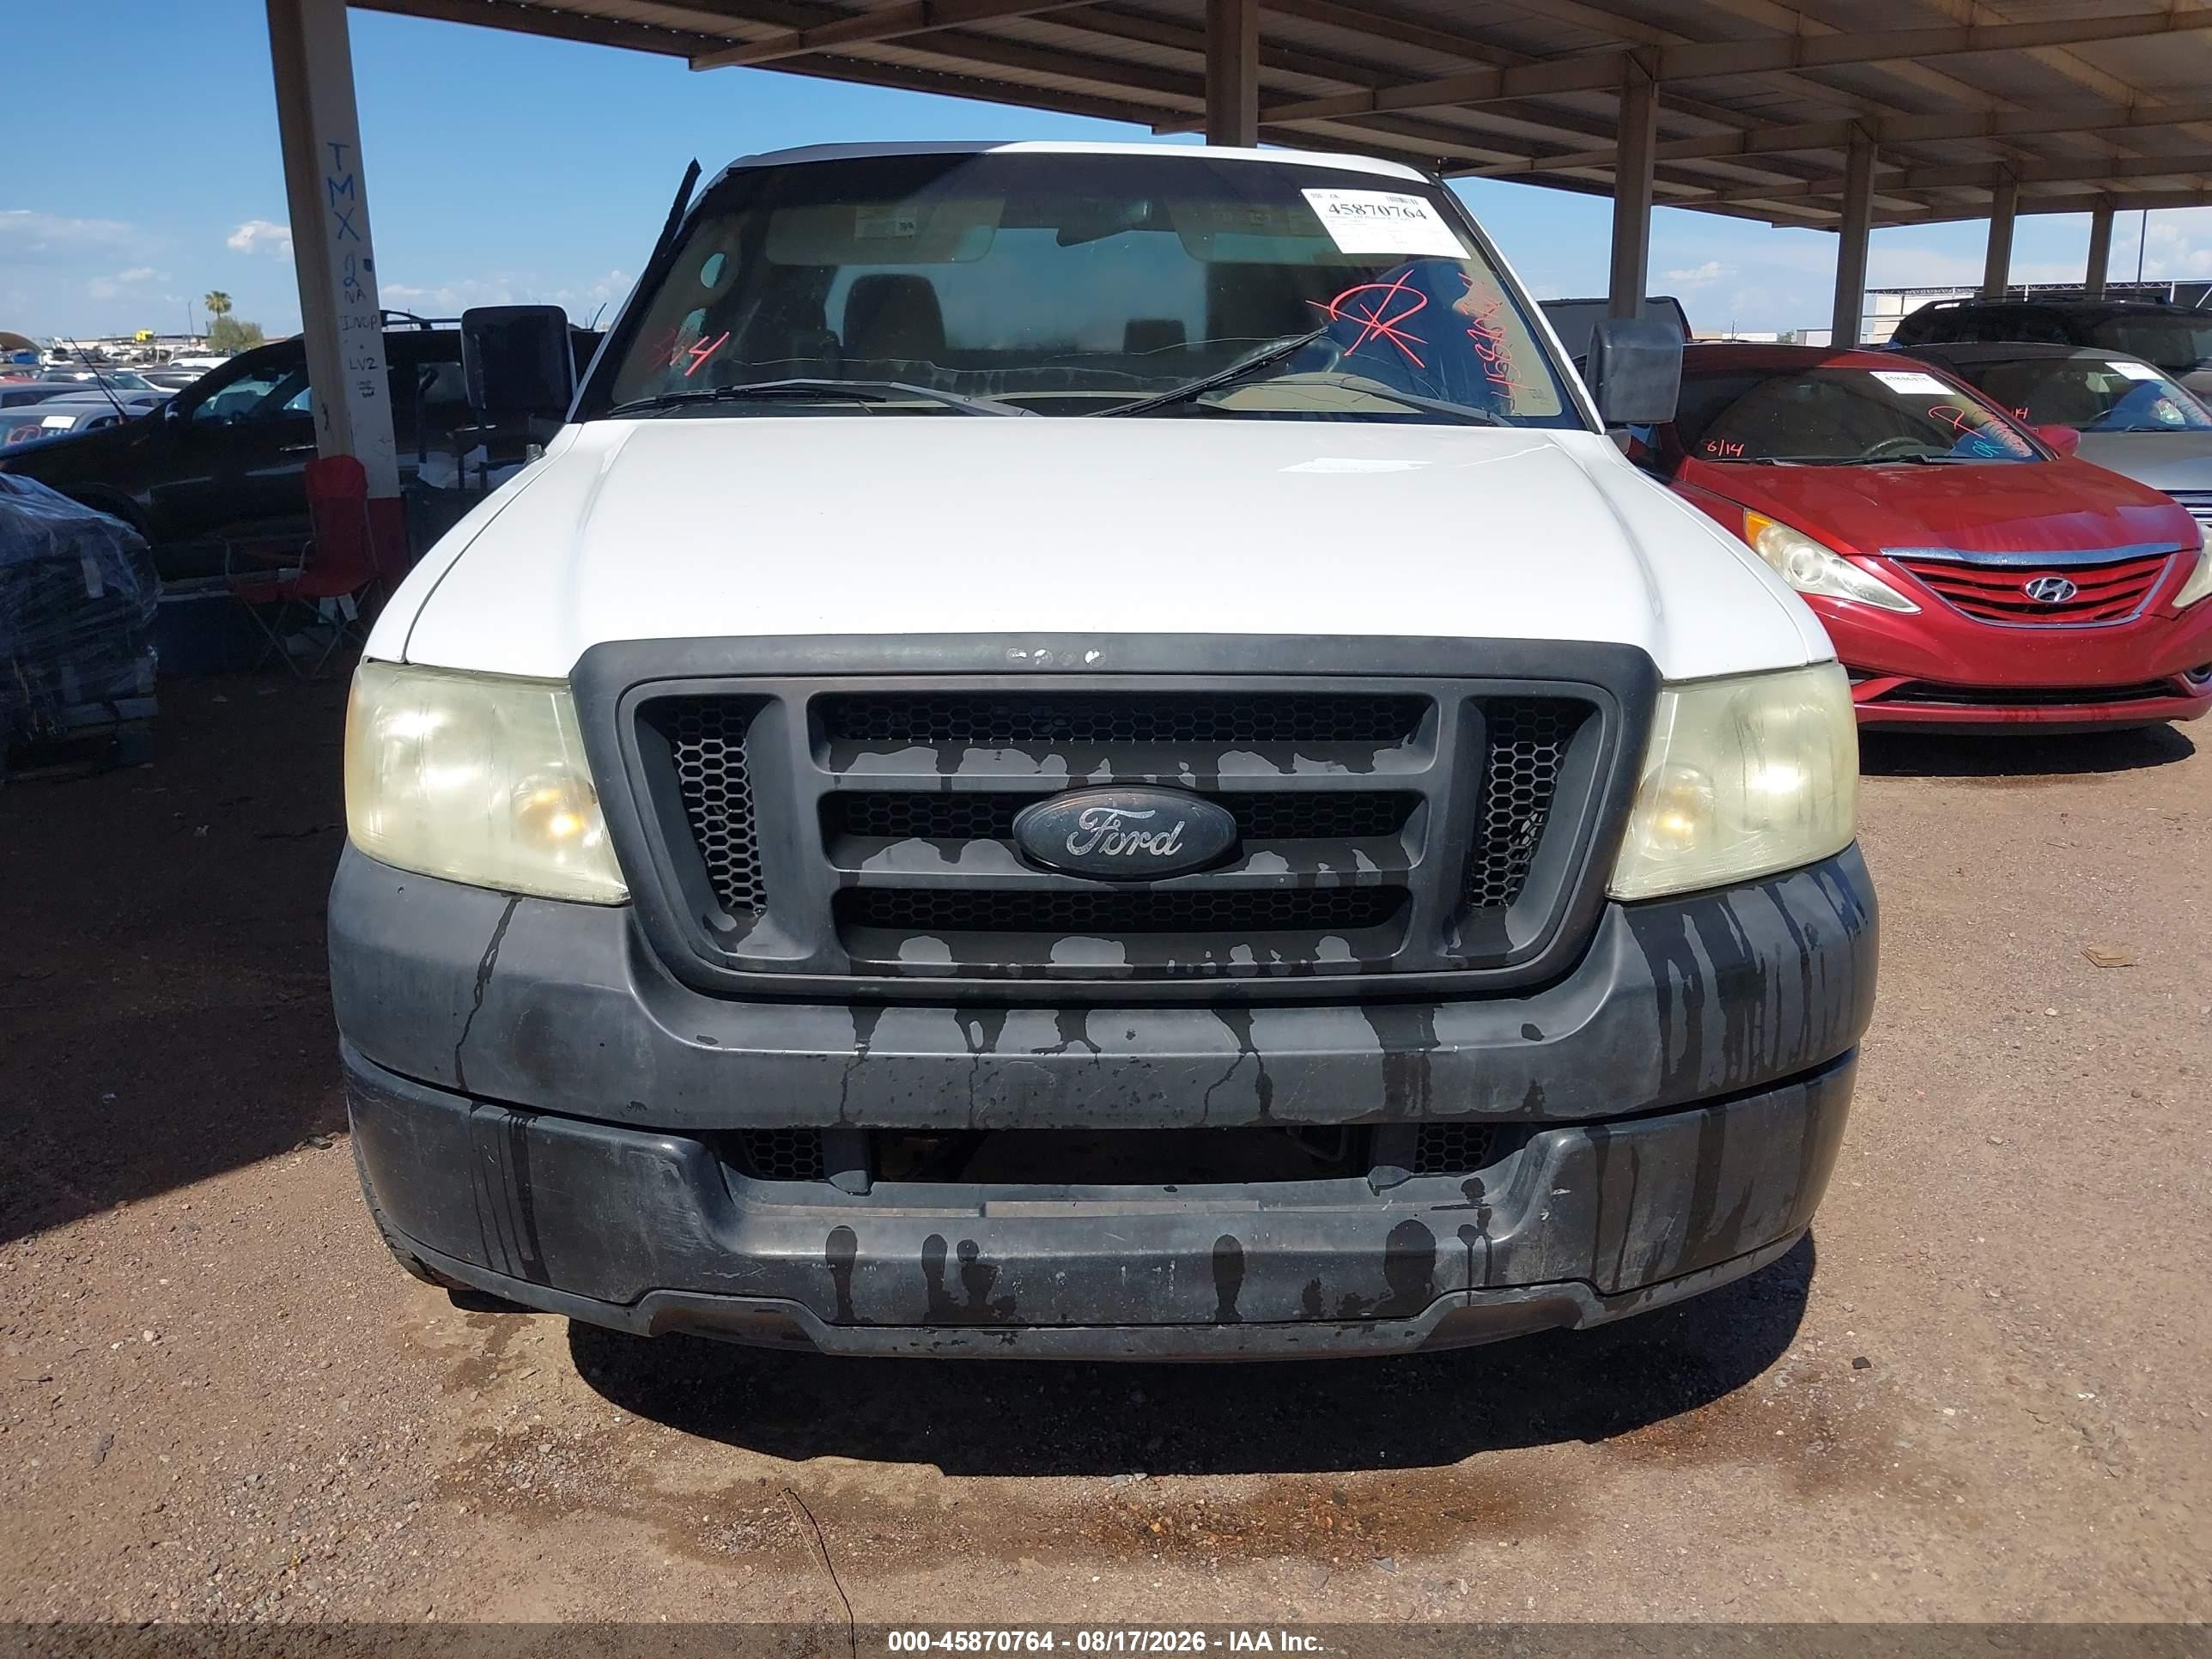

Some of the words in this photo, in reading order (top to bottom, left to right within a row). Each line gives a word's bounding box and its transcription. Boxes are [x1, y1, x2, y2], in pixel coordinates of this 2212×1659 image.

[1328, 203, 1428, 221] 45870764
[349, 356, 379, 371] LV2
[1707, 439, 1745, 457] 6/14
[1066, 807, 1185, 856] Ford
